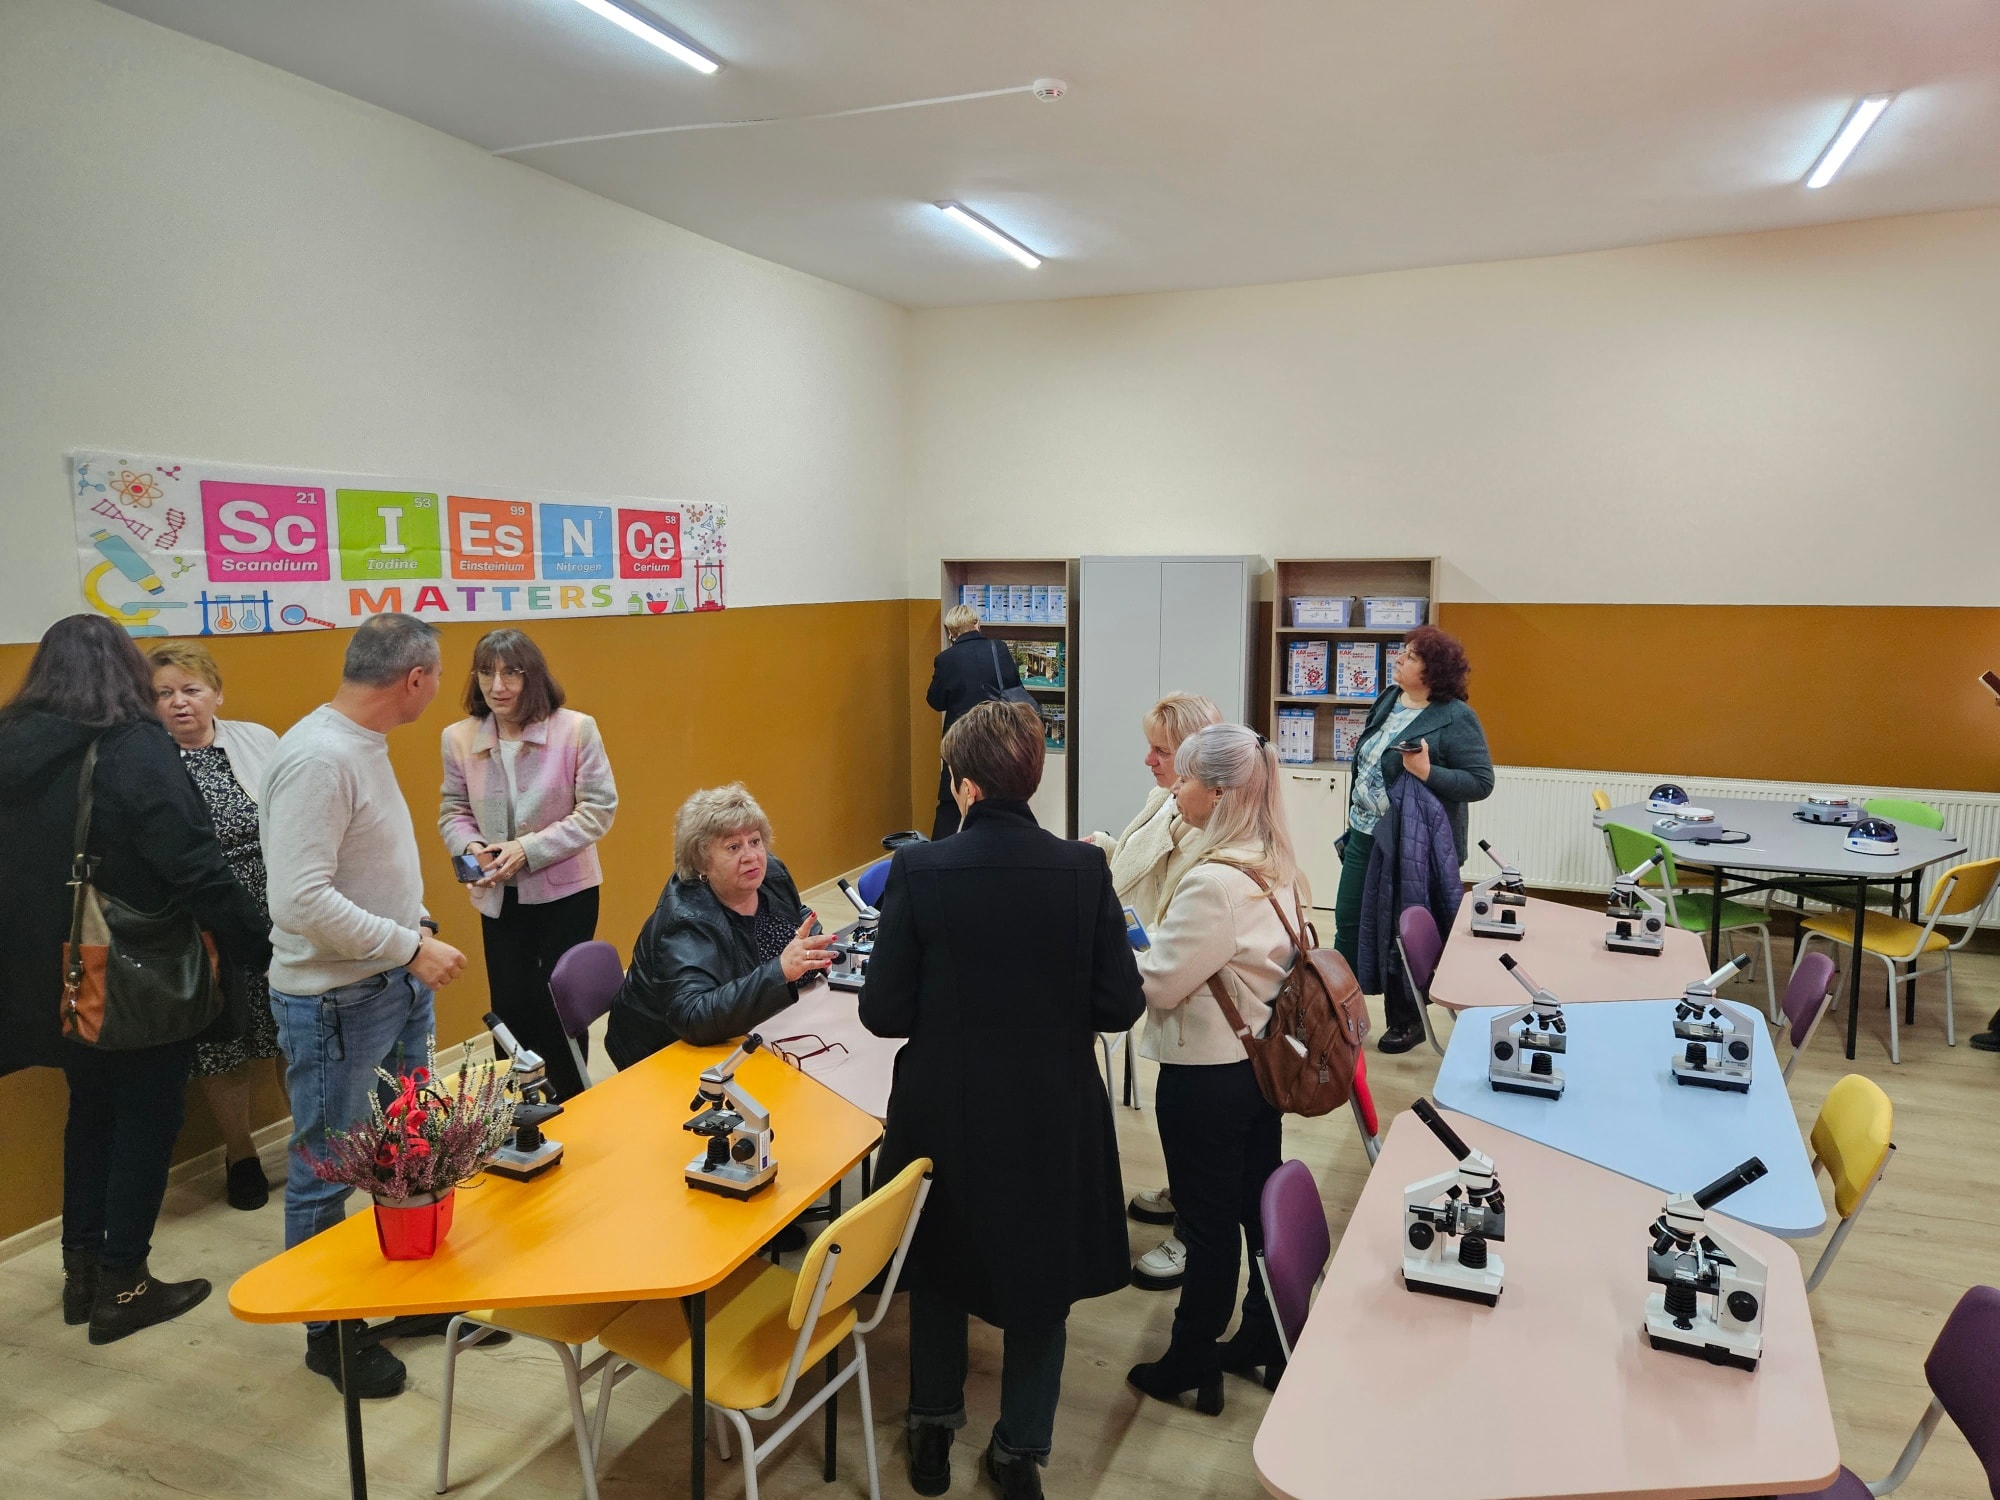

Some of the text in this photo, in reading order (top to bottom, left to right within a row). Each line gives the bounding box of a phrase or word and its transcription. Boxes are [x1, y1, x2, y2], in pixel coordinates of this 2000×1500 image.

[296, 492, 317, 504] 21
[414, 497, 431, 508] 53
[510, 505, 525, 516] 99
[597, 511, 604, 520] 7
[665, 515, 676, 525] 58
[218, 500, 675, 560] Sc I Es N Ce
[221, 558, 318, 572] Scandium
[367, 558, 418, 570] Iodine
[459, 560, 525, 572] Einsteinium
[556, 562, 601, 573] Nitrogen
[633, 562, 670, 572] Cerium
[349, 585, 613, 616] MATTERS
